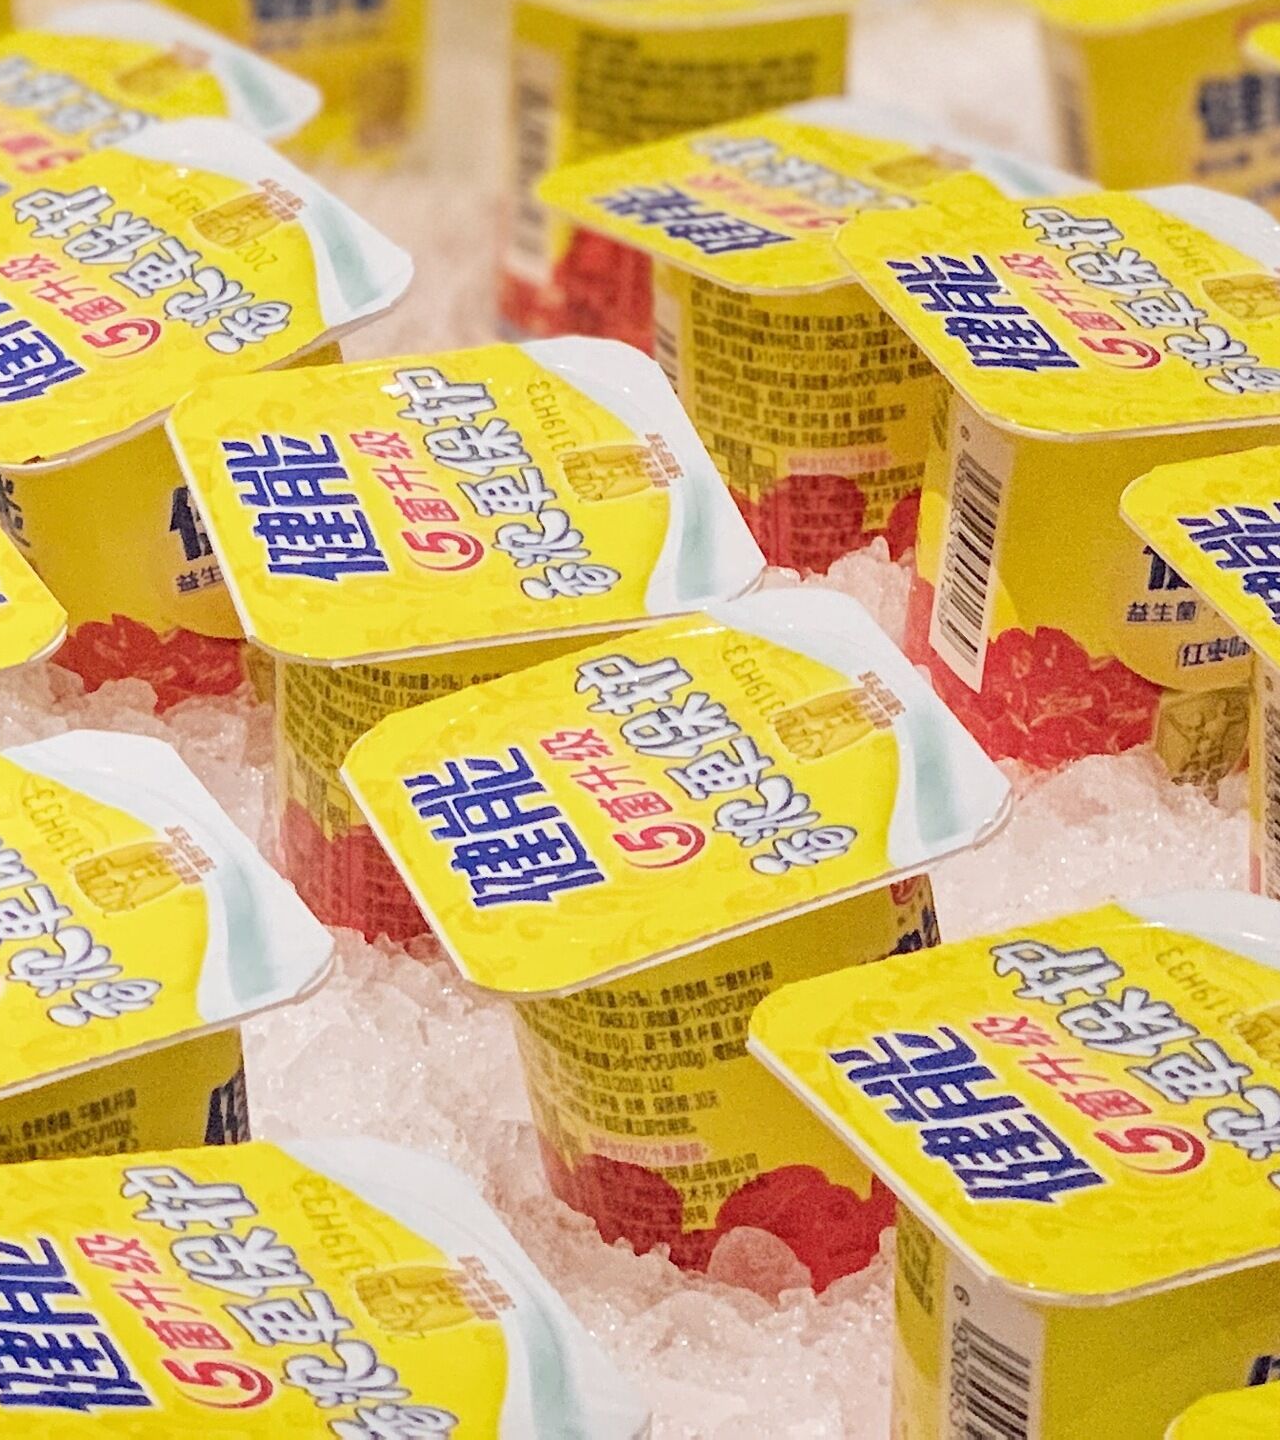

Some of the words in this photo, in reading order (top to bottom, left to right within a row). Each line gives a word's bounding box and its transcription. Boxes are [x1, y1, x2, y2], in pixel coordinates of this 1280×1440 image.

[12, 183, 294, 356] 香浓更保护
[887, 251, 1082, 372] 健能
[997, 251, 1163, 371] 5菌升级
[221, 431, 391, 584] 健能
[348, 428, 486, 573] 5菌升级
[380, 365, 624, 604] 香浓更保护
[1125, 601, 1200, 624] 益生菌
[403, 744, 608, 909] 健能
[538, 726, 708, 871] 5菌升级
[575, 653, 860, 878] 香浓更保护
[830, 1025, 1116, 1206] 健能
[969, 1013, 1208, 1176] 5菌升级
[74, 1232, 276, 1410] 5菌升级
